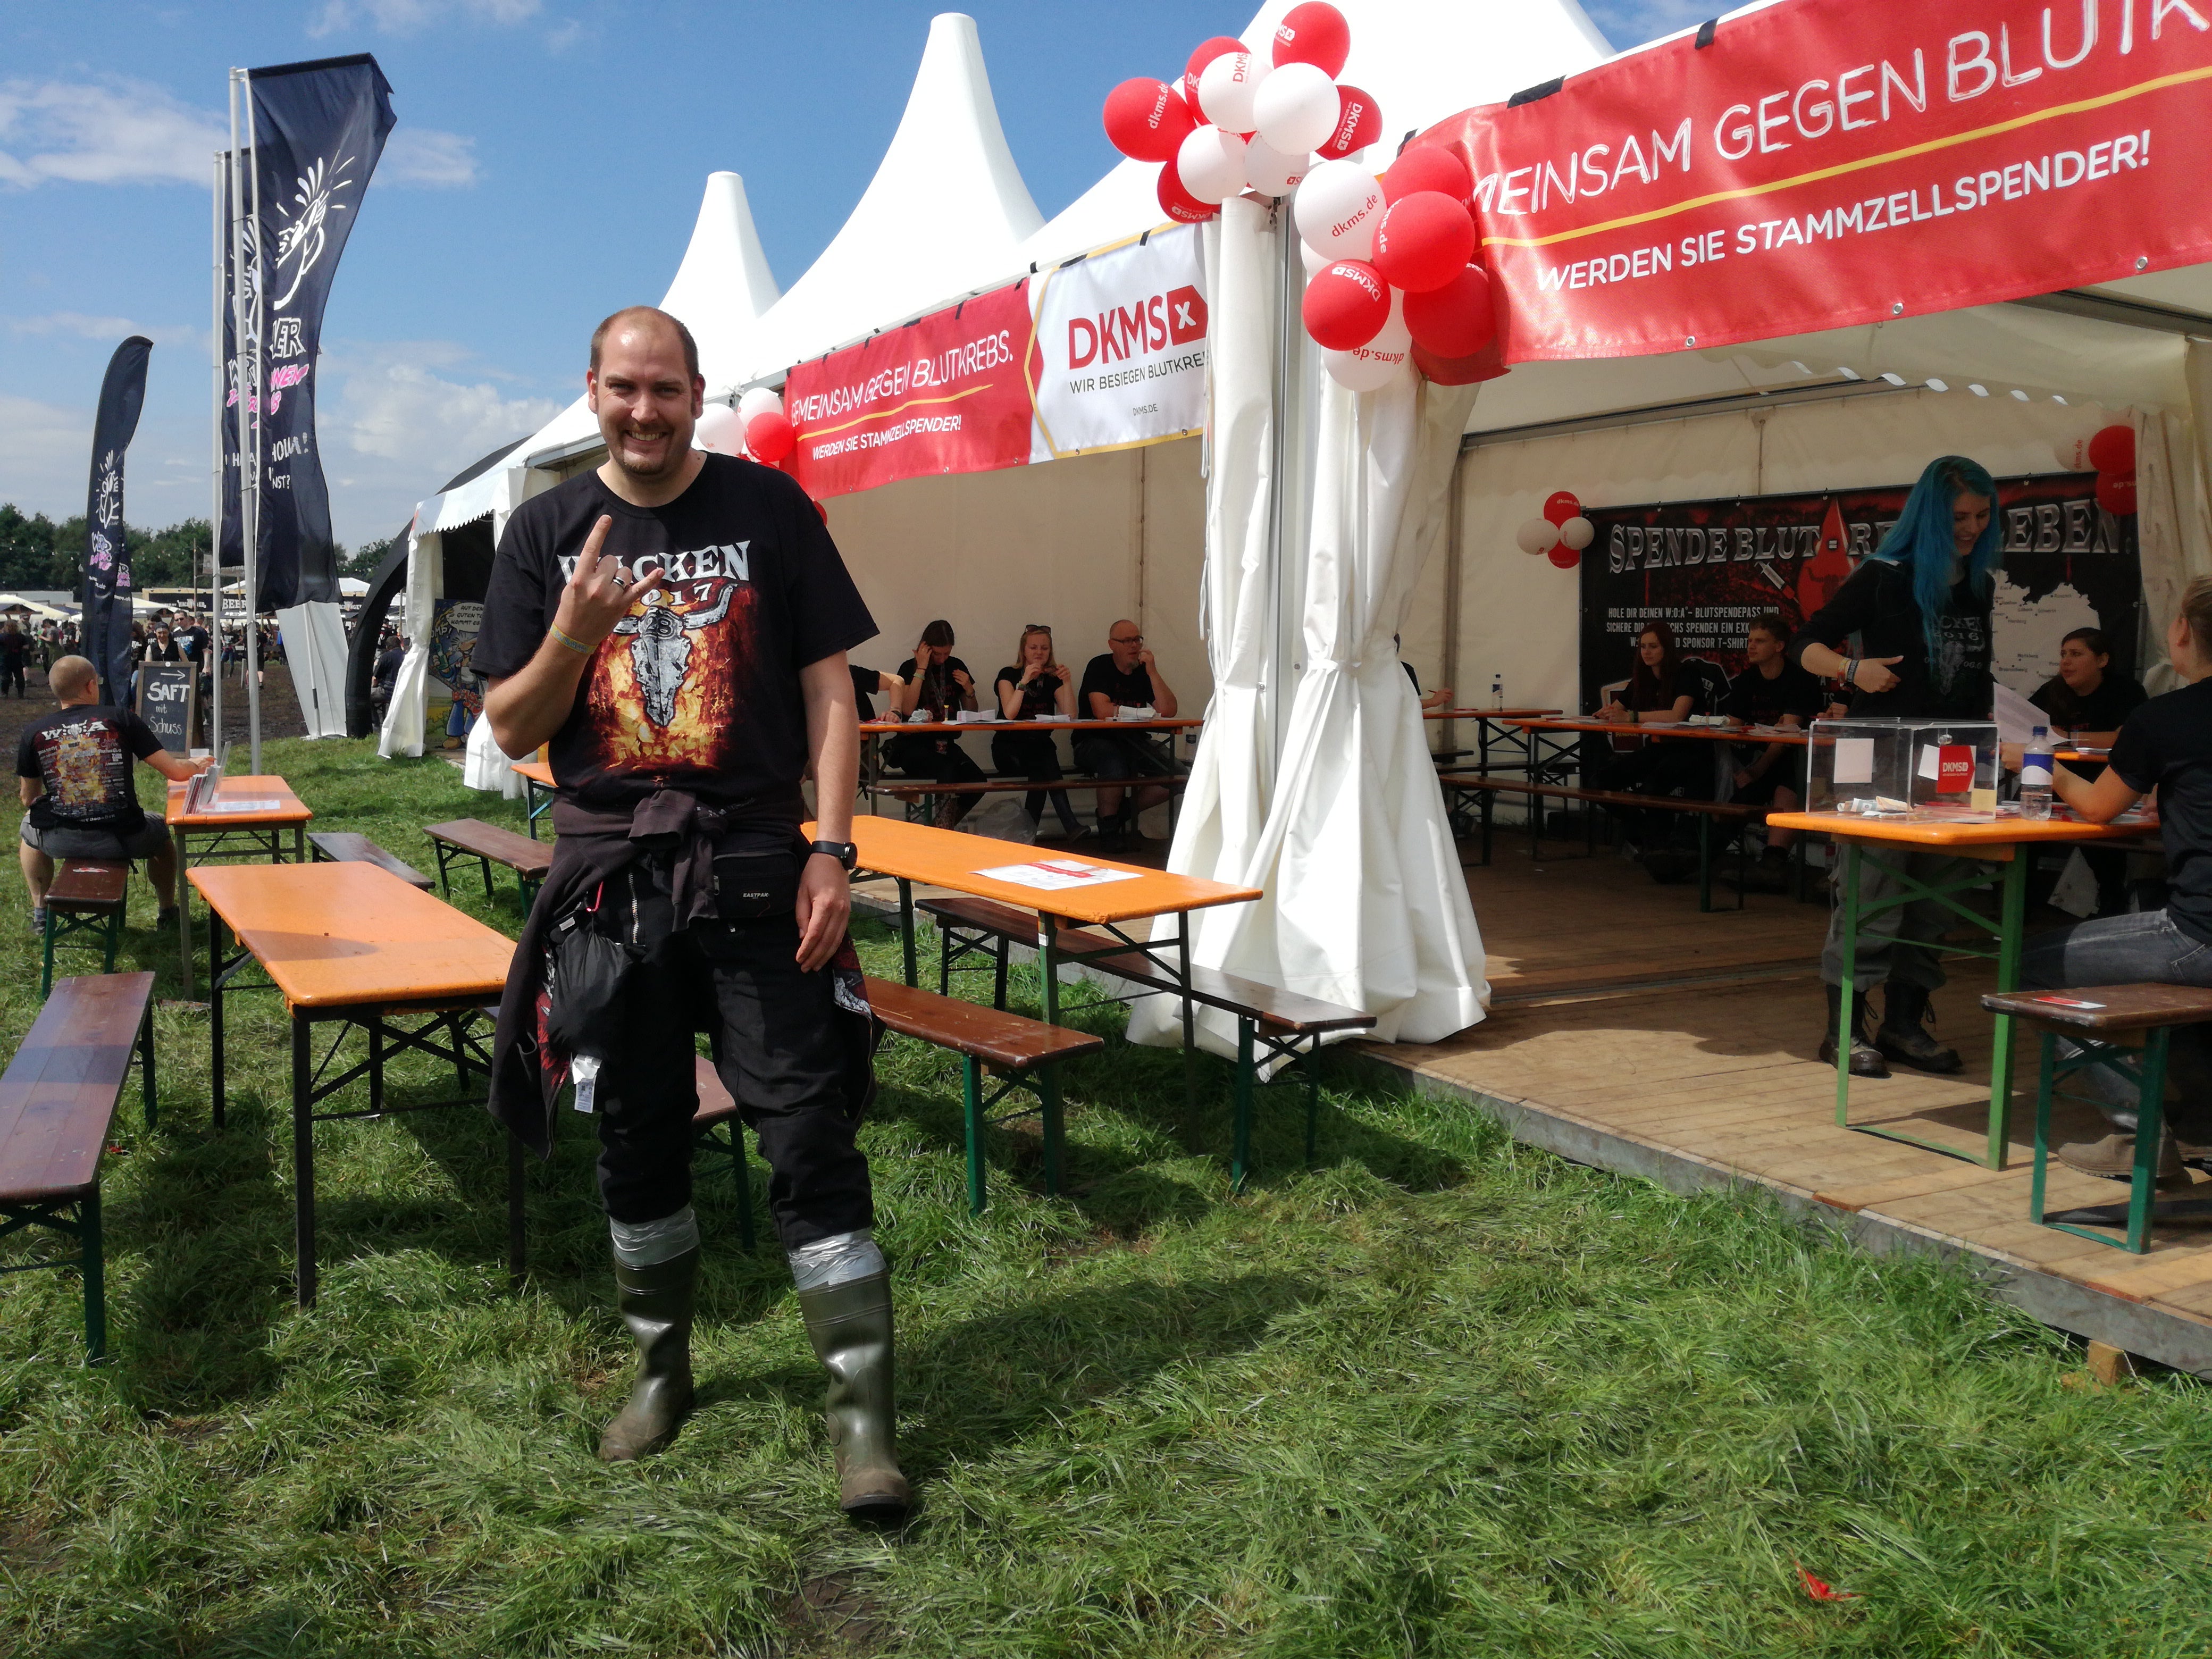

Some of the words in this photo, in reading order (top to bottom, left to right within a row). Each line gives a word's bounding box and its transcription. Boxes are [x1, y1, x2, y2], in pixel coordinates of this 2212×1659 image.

[1233, 53, 1248, 82] DKMS
[1147, 83, 1169, 129] dkms.de
[1714, 48, 1926, 160] GEGEN
[1341, 103, 1363, 141] DKMS
[1331, 195, 1378, 237] dkms.de
[1538, 244, 1672, 291] WERDEN
[1681, 230, 1725, 267] SIE
[1736, 129, 2151, 255] STAMMZELLSPENDER!
[1344, 269, 1381, 302] DKMS
[1069, 295, 1167, 370] DKMS
[1353, 347, 1404, 365] dkms.de
[791, 382, 863, 427] GEMEINSAM
[864, 361, 910, 404] GEGEN
[911, 330, 1013, 388] BLUTKREBS.
[1070, 378, 1095, 394] WIR
[1099, 367, 1145, 390] BESIEGEN
[1133, 404, 1158, 416] DKMS.DE
[812, 439, 845, 461] WERDEN
[845, 435, 858, 452] SIE
[860, 414, 962, 448] STAMMZELLSPENDER!
[1610, 524, 1727, 574] SPENDE
[1733, 525, 1821, 561] BLUT
[1608, 607, 1624, 619] HOLE
[1626, 607, 1638, 619] DIR
[1639, 607, 1663, 619] DEINEN
[1695, 606, 1762, 618] BLUTSPENDEPASS
[1606, 622, 1633, 633] SICHERE
[1686, 622, 1719, 634] SPENDEN
[1721, 623, 1733, 634] EIN
[1682, 637, 1715, 648] SPONSOR
[147, 682, 190, 702] SAFT
[155, 704, 167, 714] mit
[148, 716, 182, 735] Schuss
[1942, 762, 1963, 772] DKMS
